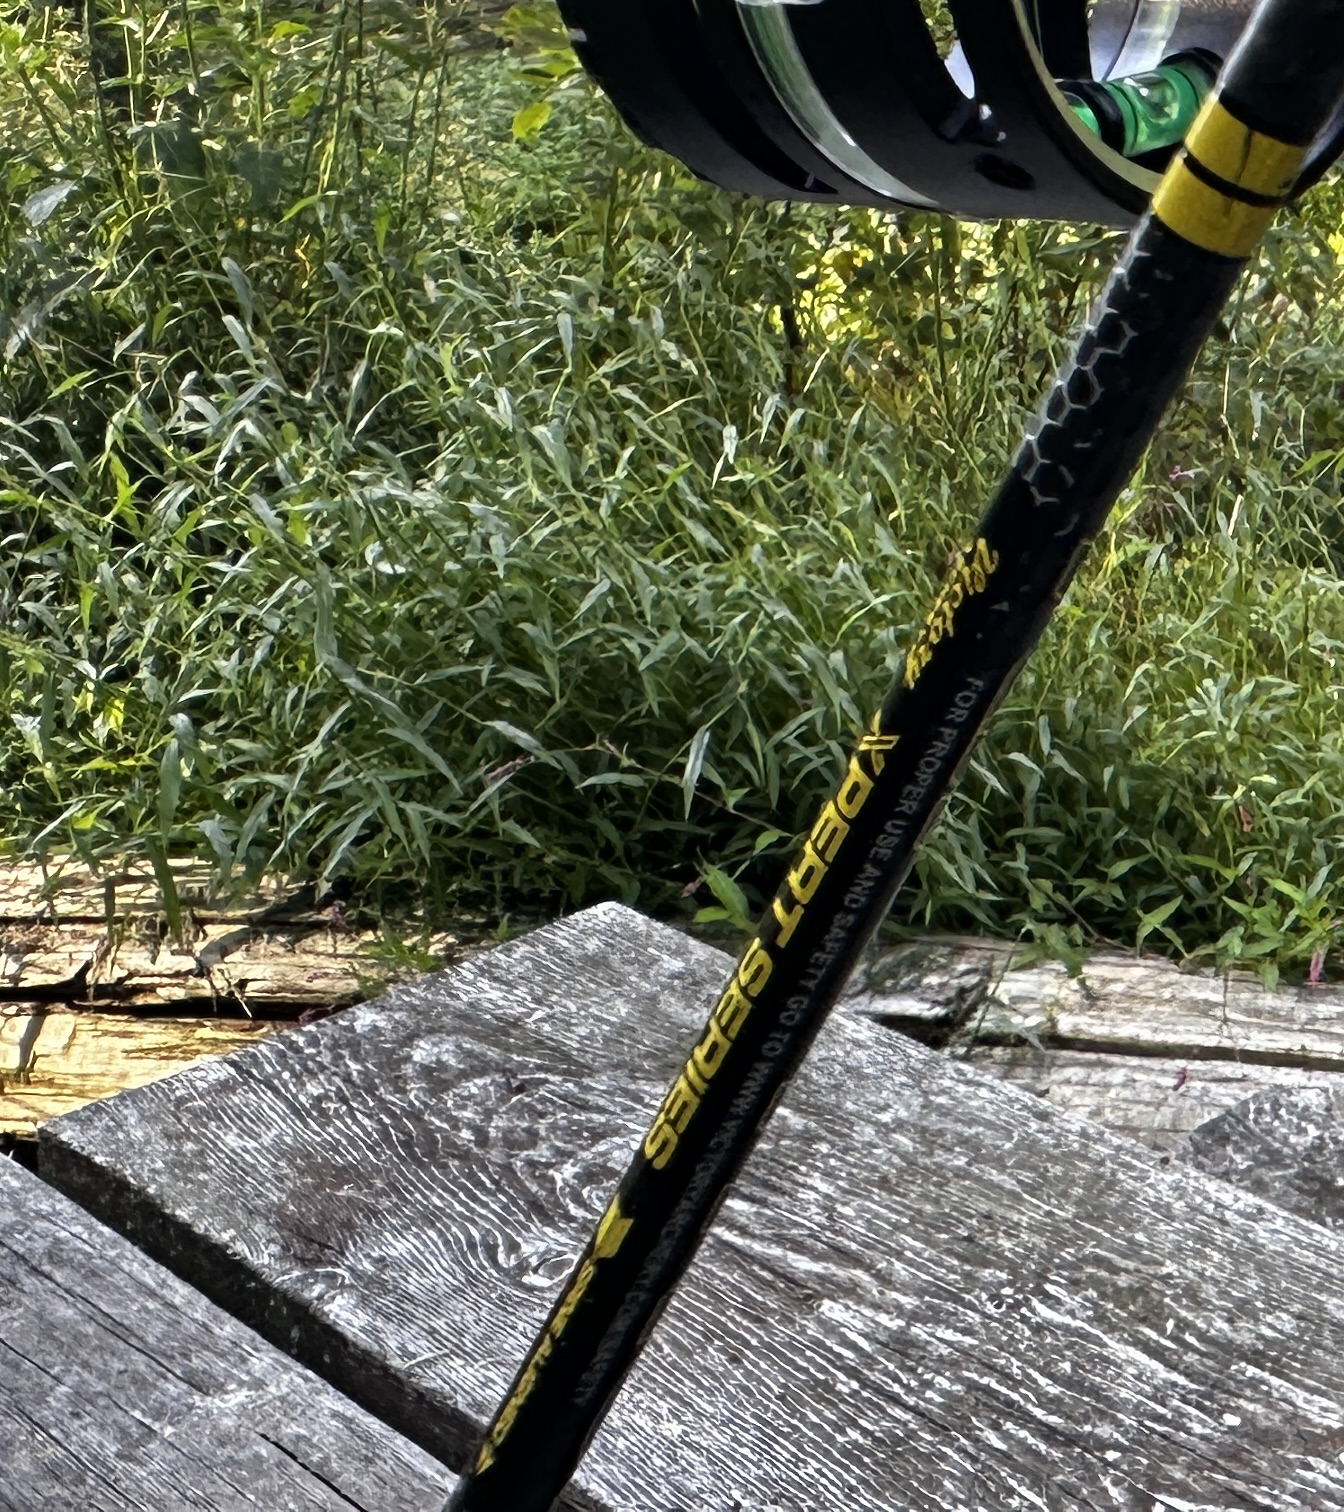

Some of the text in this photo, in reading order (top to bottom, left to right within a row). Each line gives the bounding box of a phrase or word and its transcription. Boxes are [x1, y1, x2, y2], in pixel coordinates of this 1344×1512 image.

[950, 675, 986, 726] FOR
[894, 723, 960, 819] PROPER
[868, 817, 908, 863] USE
[842, 862, 883, 912] AND
[798, 909, 857, 992] SAFETY
[779, 993, 810, 1029] GO
[643, 937, 772, 1169] SERIES
[760, 1027, 792, 1060] TO
